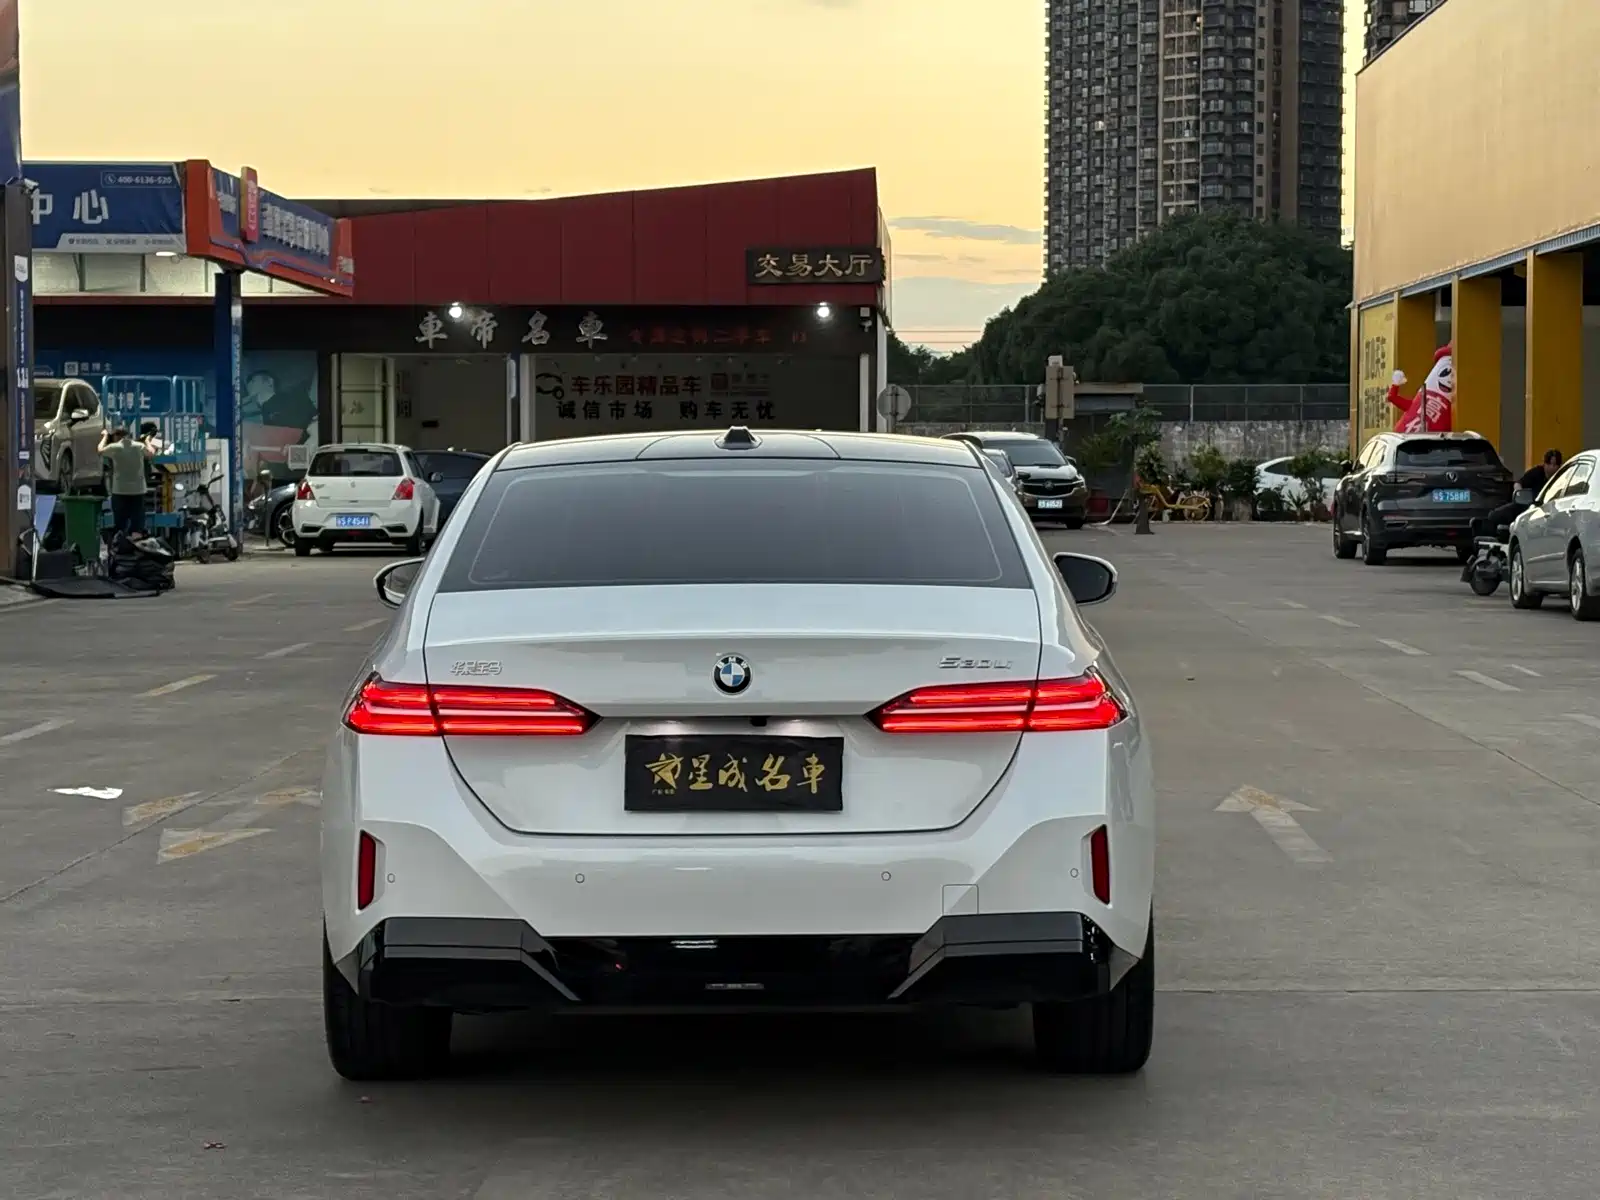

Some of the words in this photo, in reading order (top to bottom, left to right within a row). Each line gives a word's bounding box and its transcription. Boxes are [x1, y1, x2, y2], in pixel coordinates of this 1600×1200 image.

[755, 252, 875, 279] 交易大厅
[571, 375, 702, 396] 车乐园精品车
[556, 400, 654, 420] 诚信市场
[679, 400, 777, 420] 购车无忧
[716, 656, 749, 669] BMW
